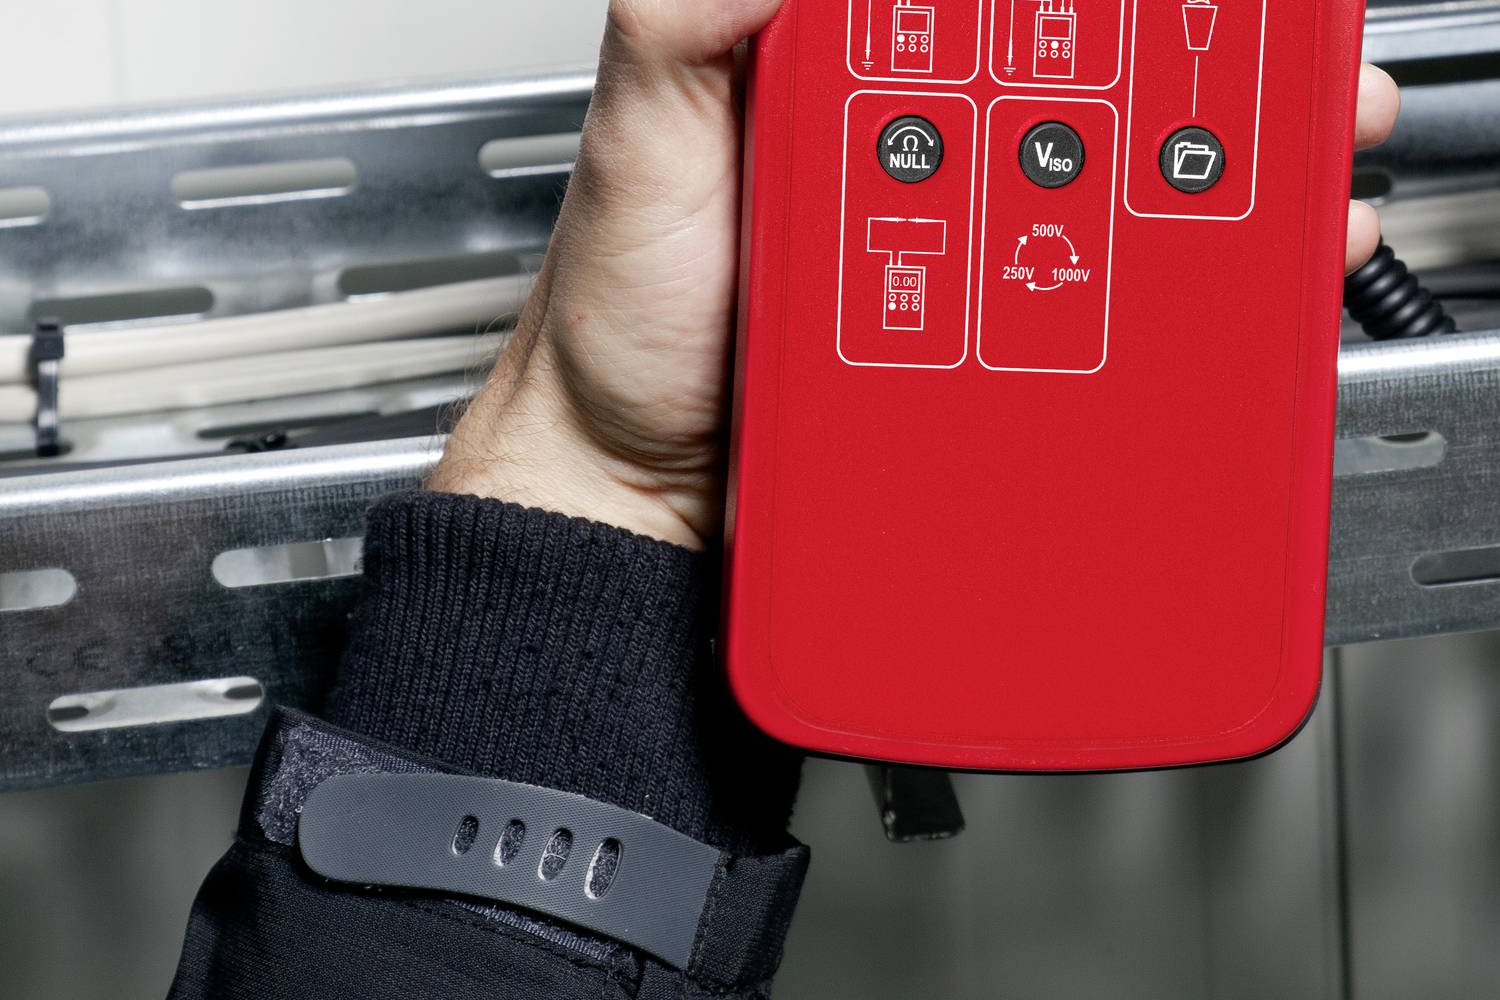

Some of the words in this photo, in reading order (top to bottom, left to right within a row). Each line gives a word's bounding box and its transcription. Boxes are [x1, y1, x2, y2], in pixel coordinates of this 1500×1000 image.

[890, 153, 930, 168] NULL
[1035, 141, 1073, 172] VISO
[1032, 223, 1064, 237] 500V
[1002, 266, 1035, 280] 250V
[1051, 268, 1091, 282] 1000V
[892, 276, 917, 287] 0.00
